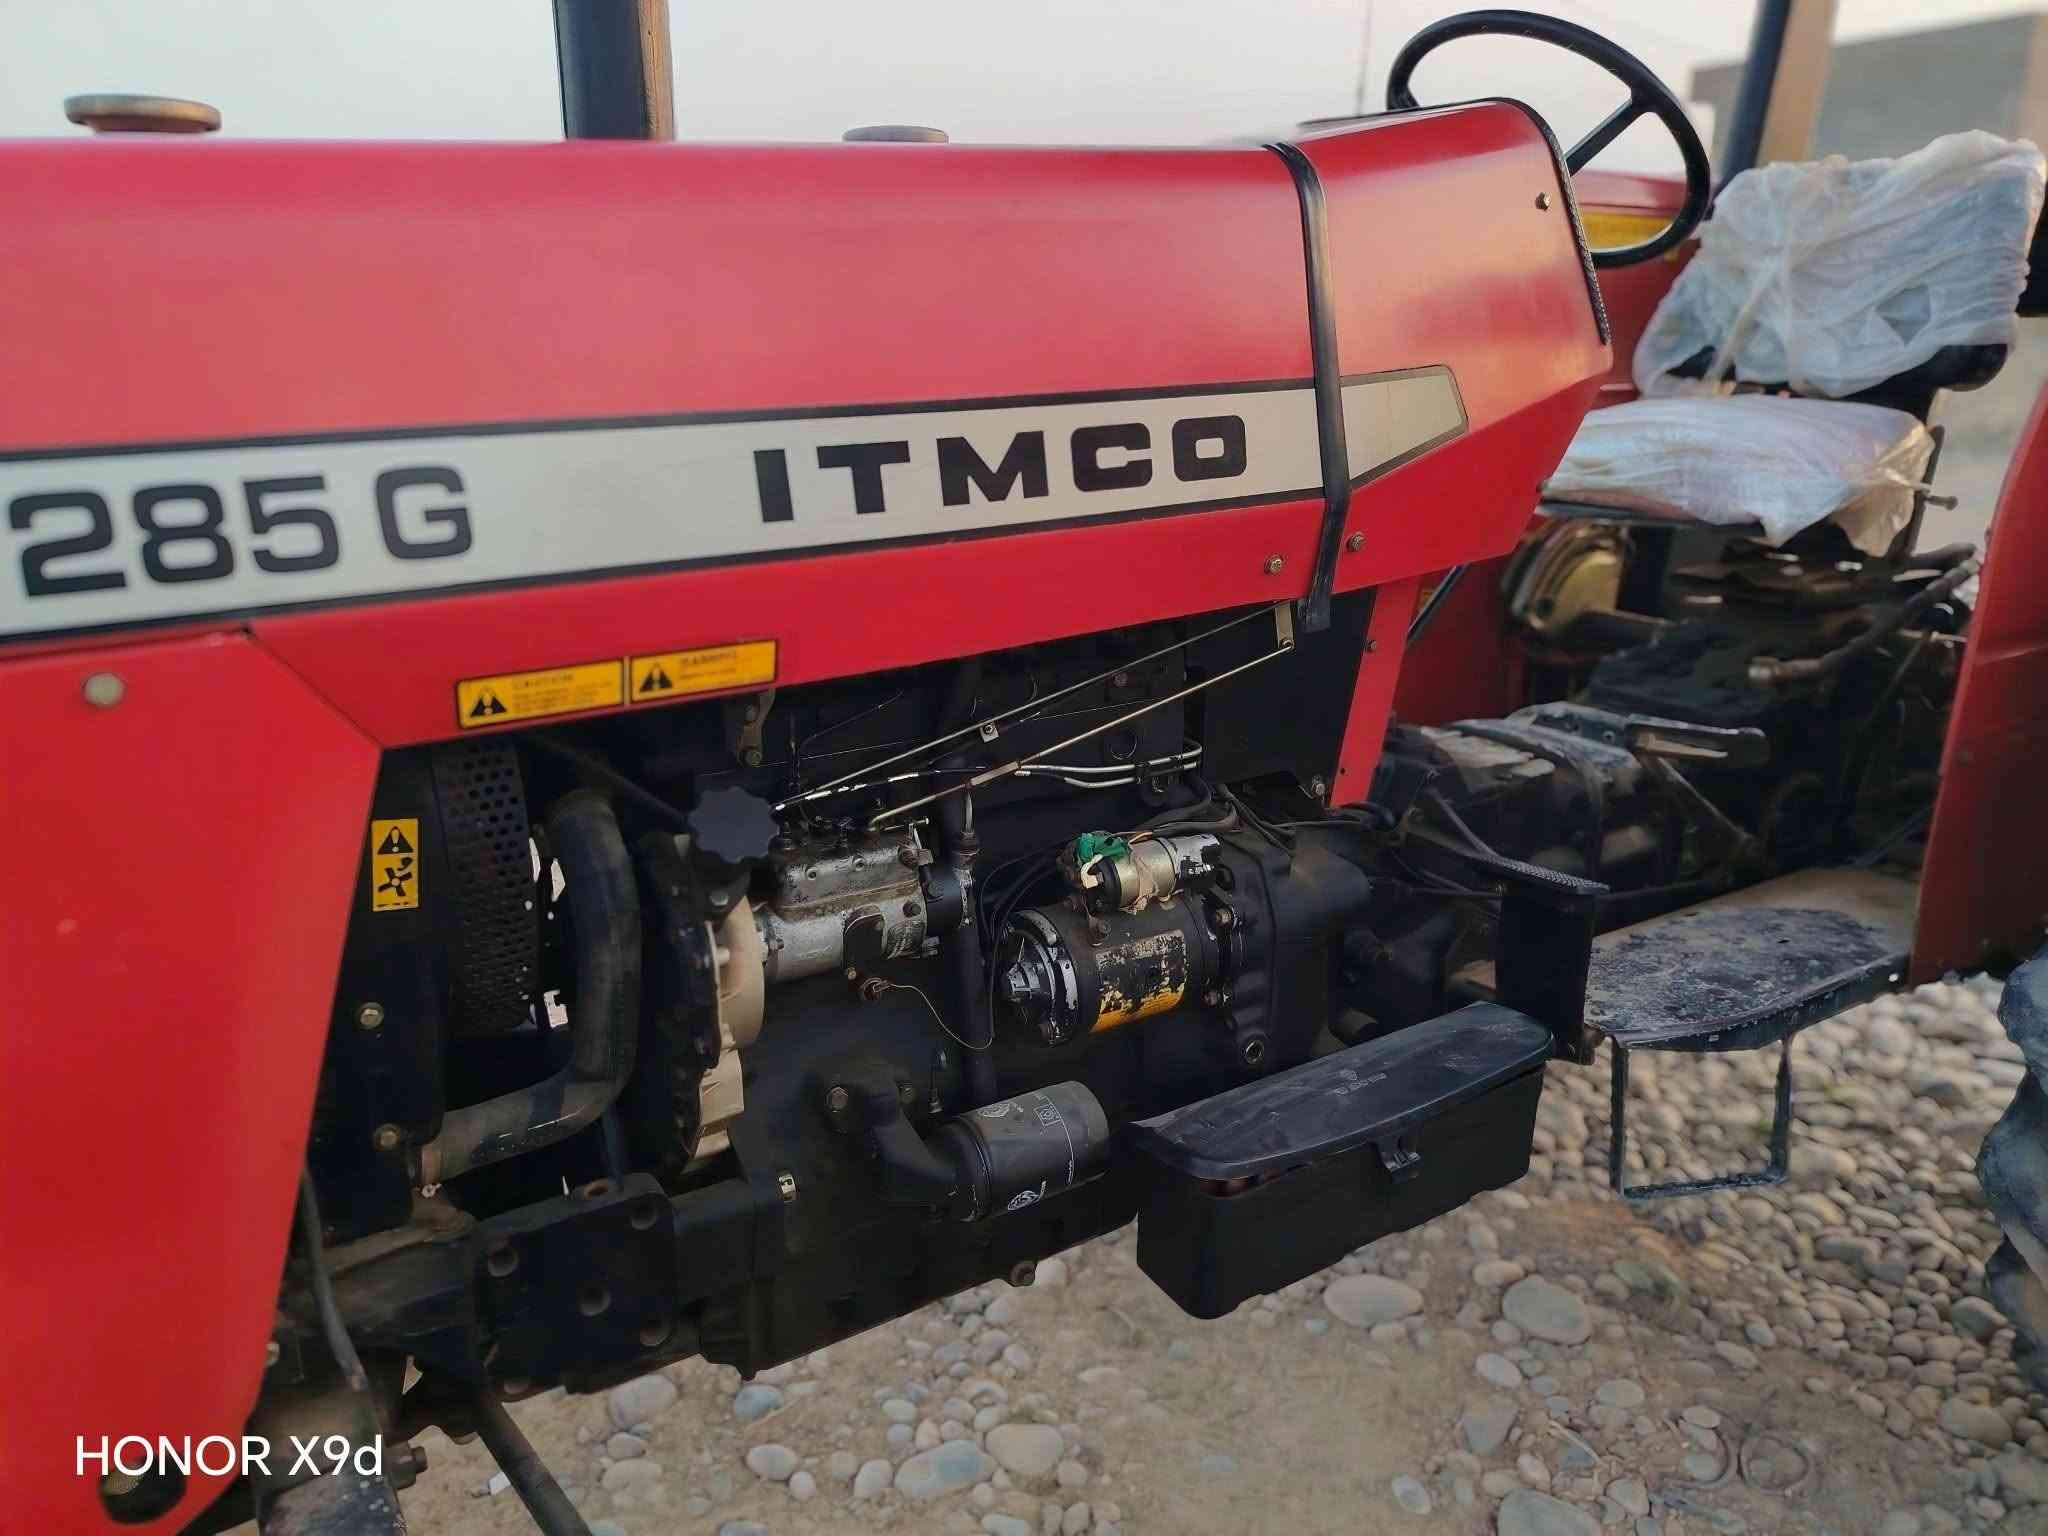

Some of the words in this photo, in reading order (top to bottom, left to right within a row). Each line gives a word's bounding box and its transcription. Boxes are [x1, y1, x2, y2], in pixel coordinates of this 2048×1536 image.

[754, 415, 1248, 523] ITMCO
[9, 475, 340, 598] 285
[375, 467, 472, 560] G
